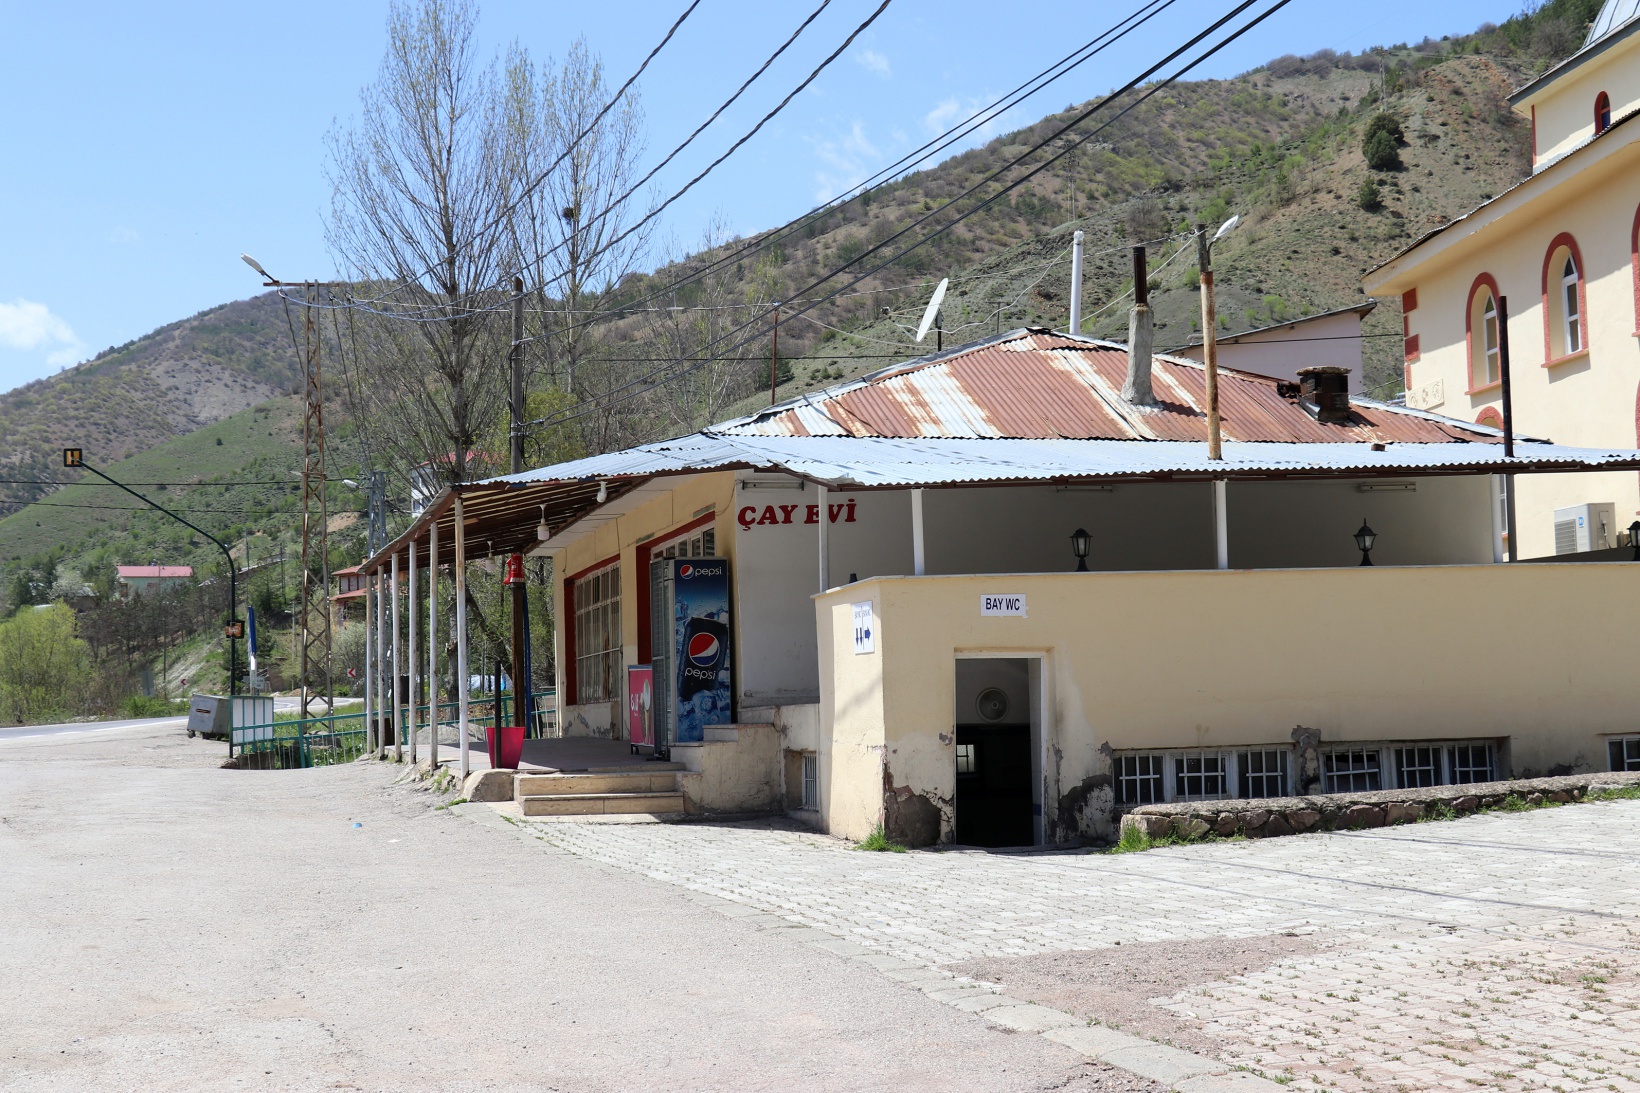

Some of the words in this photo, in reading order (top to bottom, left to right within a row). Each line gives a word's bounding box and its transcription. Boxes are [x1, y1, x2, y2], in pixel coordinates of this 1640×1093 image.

[738, 504, 798, 531] ÇAY
[804, 498, 857, 524] EVİ
[695, 567, 722, 577] pepsi
[985, 597, 1004, 610] BAY
[1005, 598, 1020, 611] WC
[684, 667, 717, 680] pepsi
